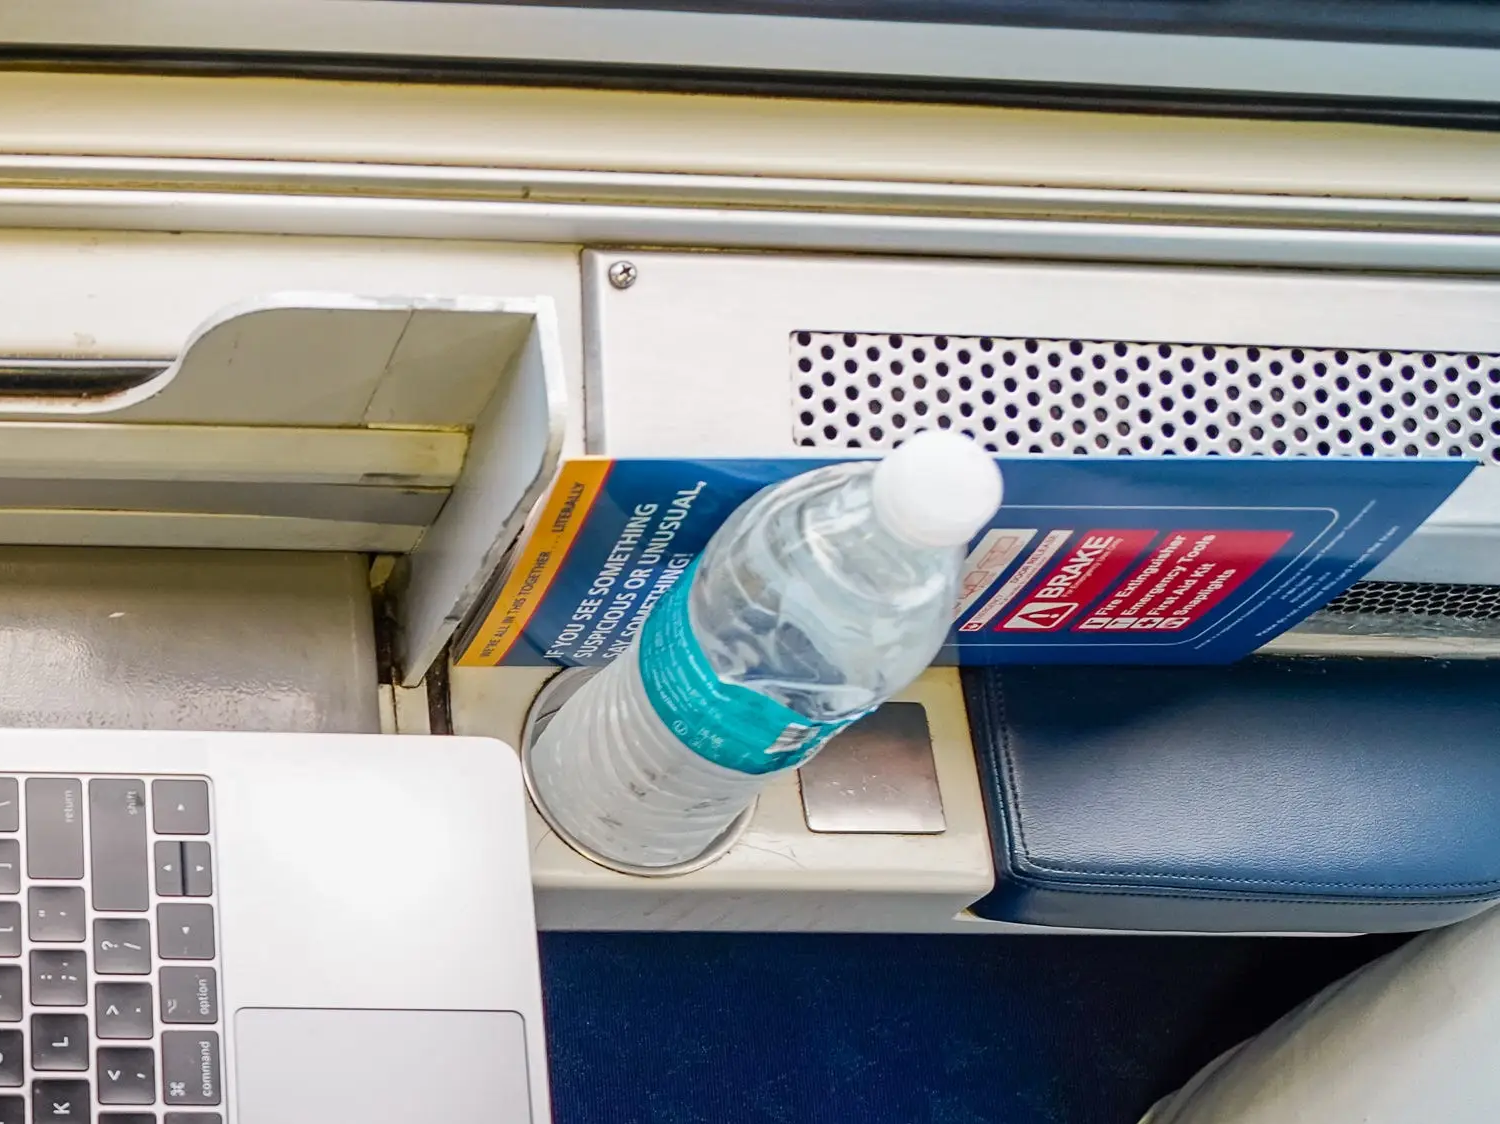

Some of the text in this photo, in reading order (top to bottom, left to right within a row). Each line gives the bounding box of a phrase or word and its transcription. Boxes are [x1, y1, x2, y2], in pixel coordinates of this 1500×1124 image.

[518, 551, 552, 595] TOGETHER
[551, 482, 584, 532] LITERALLY
[637, 481, 707, 564] UNUSUAL,
[551, 624, 585, 647] YOU
[572, 599, 603, 620] SEE
[588, 504, 658, 595] SOMETHING
[624, 568, 653, 589] OR
[1034, 535, 1115, 598] BRAKE
[1115, 534, 1187, 597] Extinguisher
[1120, 535, 1216, 615] Emergency Tools
[1146, 596, 1179, 615] First
[1173, 569, 1236, 615] Snaplights
[573, 593, 637, 658] SUSPICIOUS
[602, 639, 631, 658] SAY
[64, 790, 74, 822] return
[125, 791, 138, 815] shift
[197, 979, 210, 1015] option
[52, 1037, 69, 1047] L
[199, 1041, 213, 1097] command
[53, 1102, 70, 1114] K
